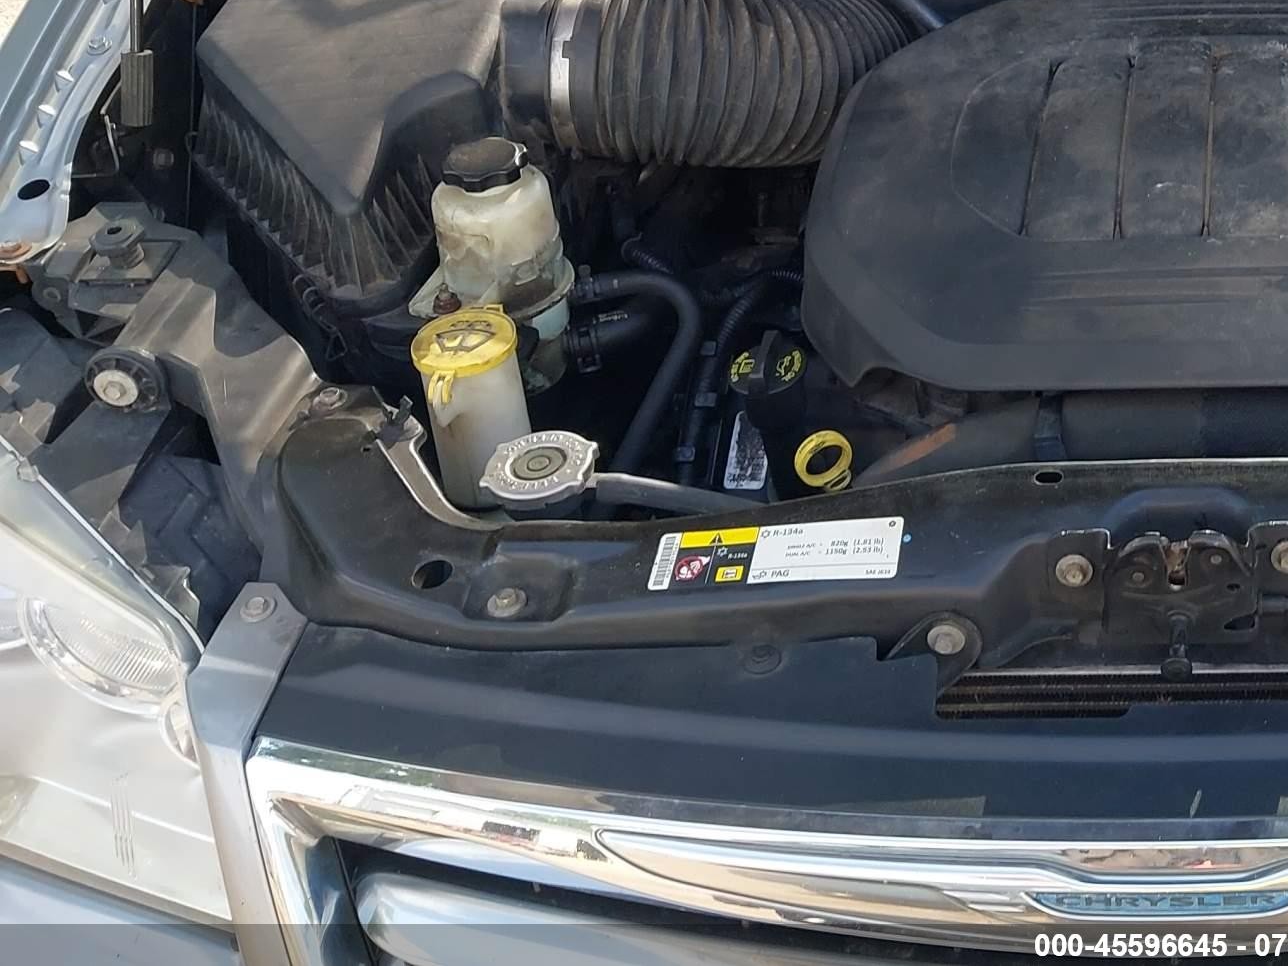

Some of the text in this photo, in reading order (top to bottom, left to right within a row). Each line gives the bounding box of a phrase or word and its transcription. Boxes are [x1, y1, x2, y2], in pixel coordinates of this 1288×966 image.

[772, 527, 803, 537] R-134a
[771, 569, 790, 578] PAG
[1055, 895, 1276, 907] CHRYSLER
